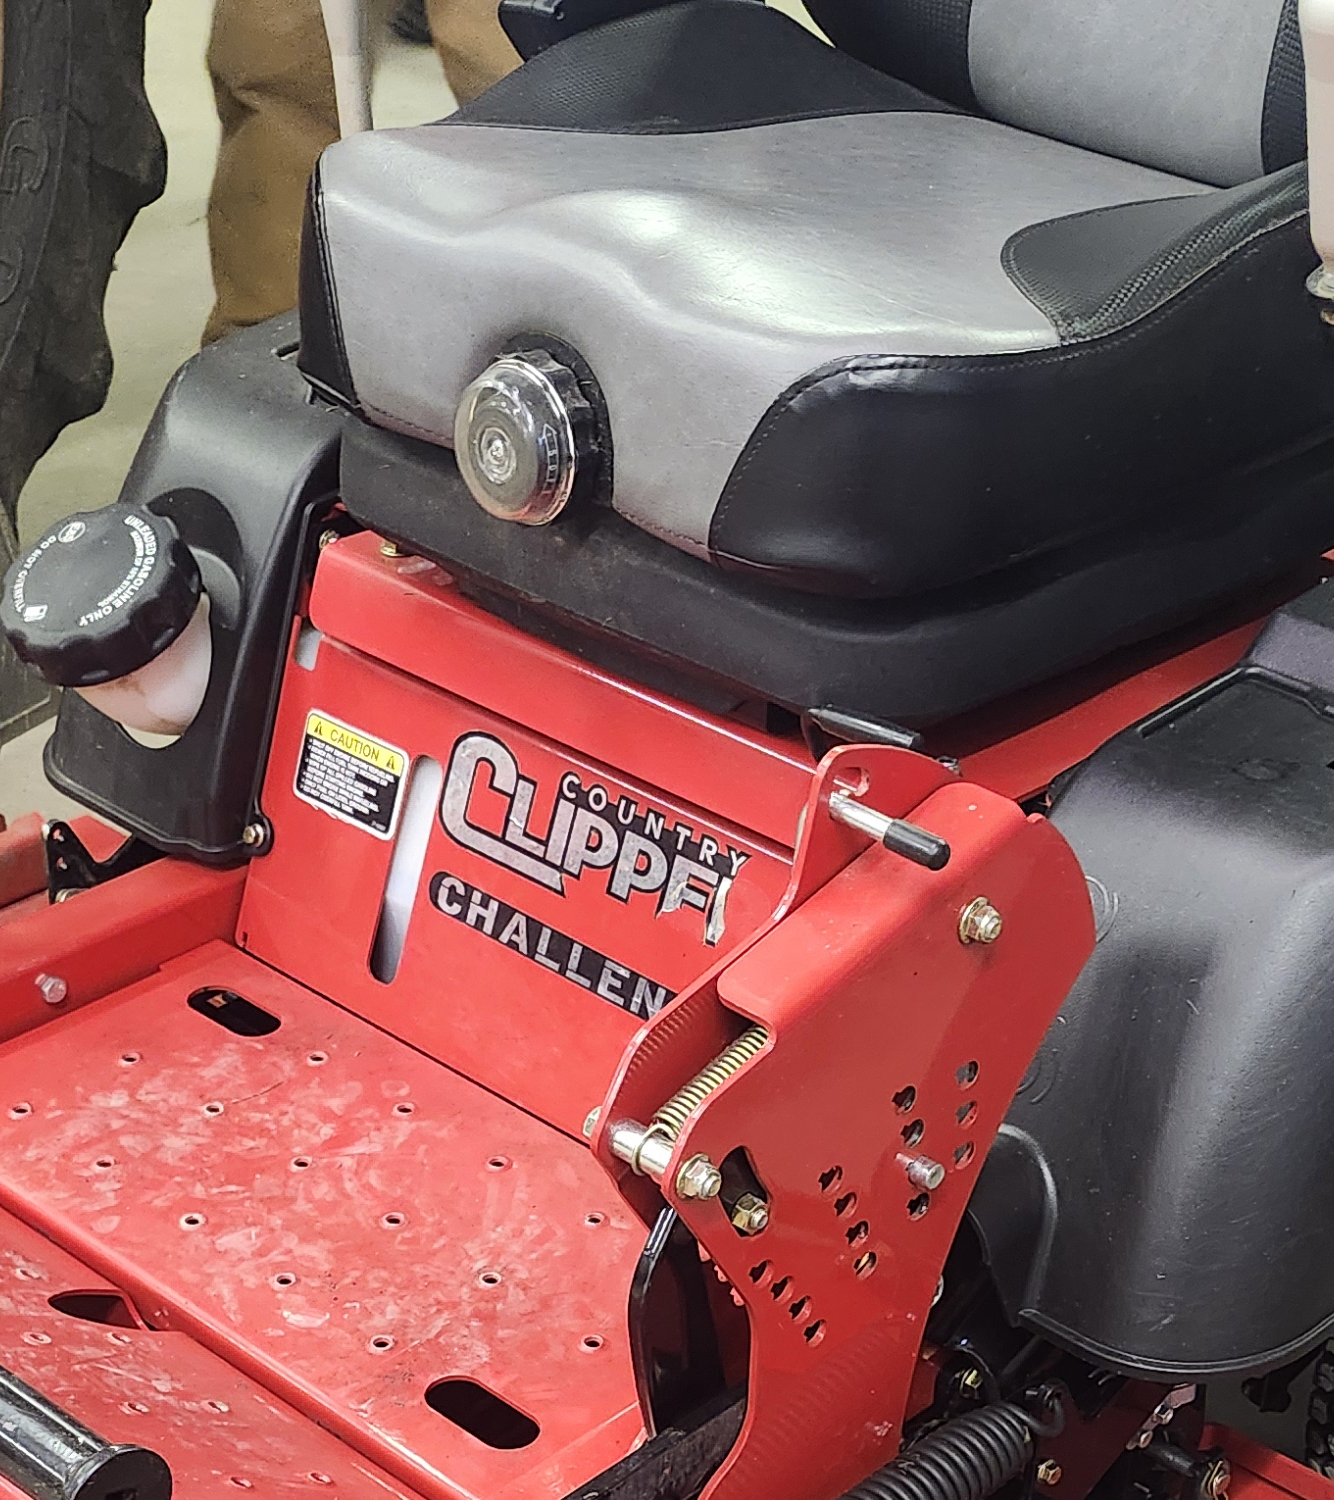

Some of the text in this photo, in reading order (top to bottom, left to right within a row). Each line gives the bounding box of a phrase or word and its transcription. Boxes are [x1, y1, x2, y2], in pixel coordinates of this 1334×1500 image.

[40, 535, 57, 549] DO
[124, 515, 157, 555] UNLEADED
[24, 549, 43, 569] NOT
[113, 556, 155, 608] GASOLINE
[79, 606, 113, 627] ONLY
[330, 729, 380, 762] CAUTION
[562, 773, 749, 876] COUNTRY
[436, 876, 667, 1019] CHALLEN
